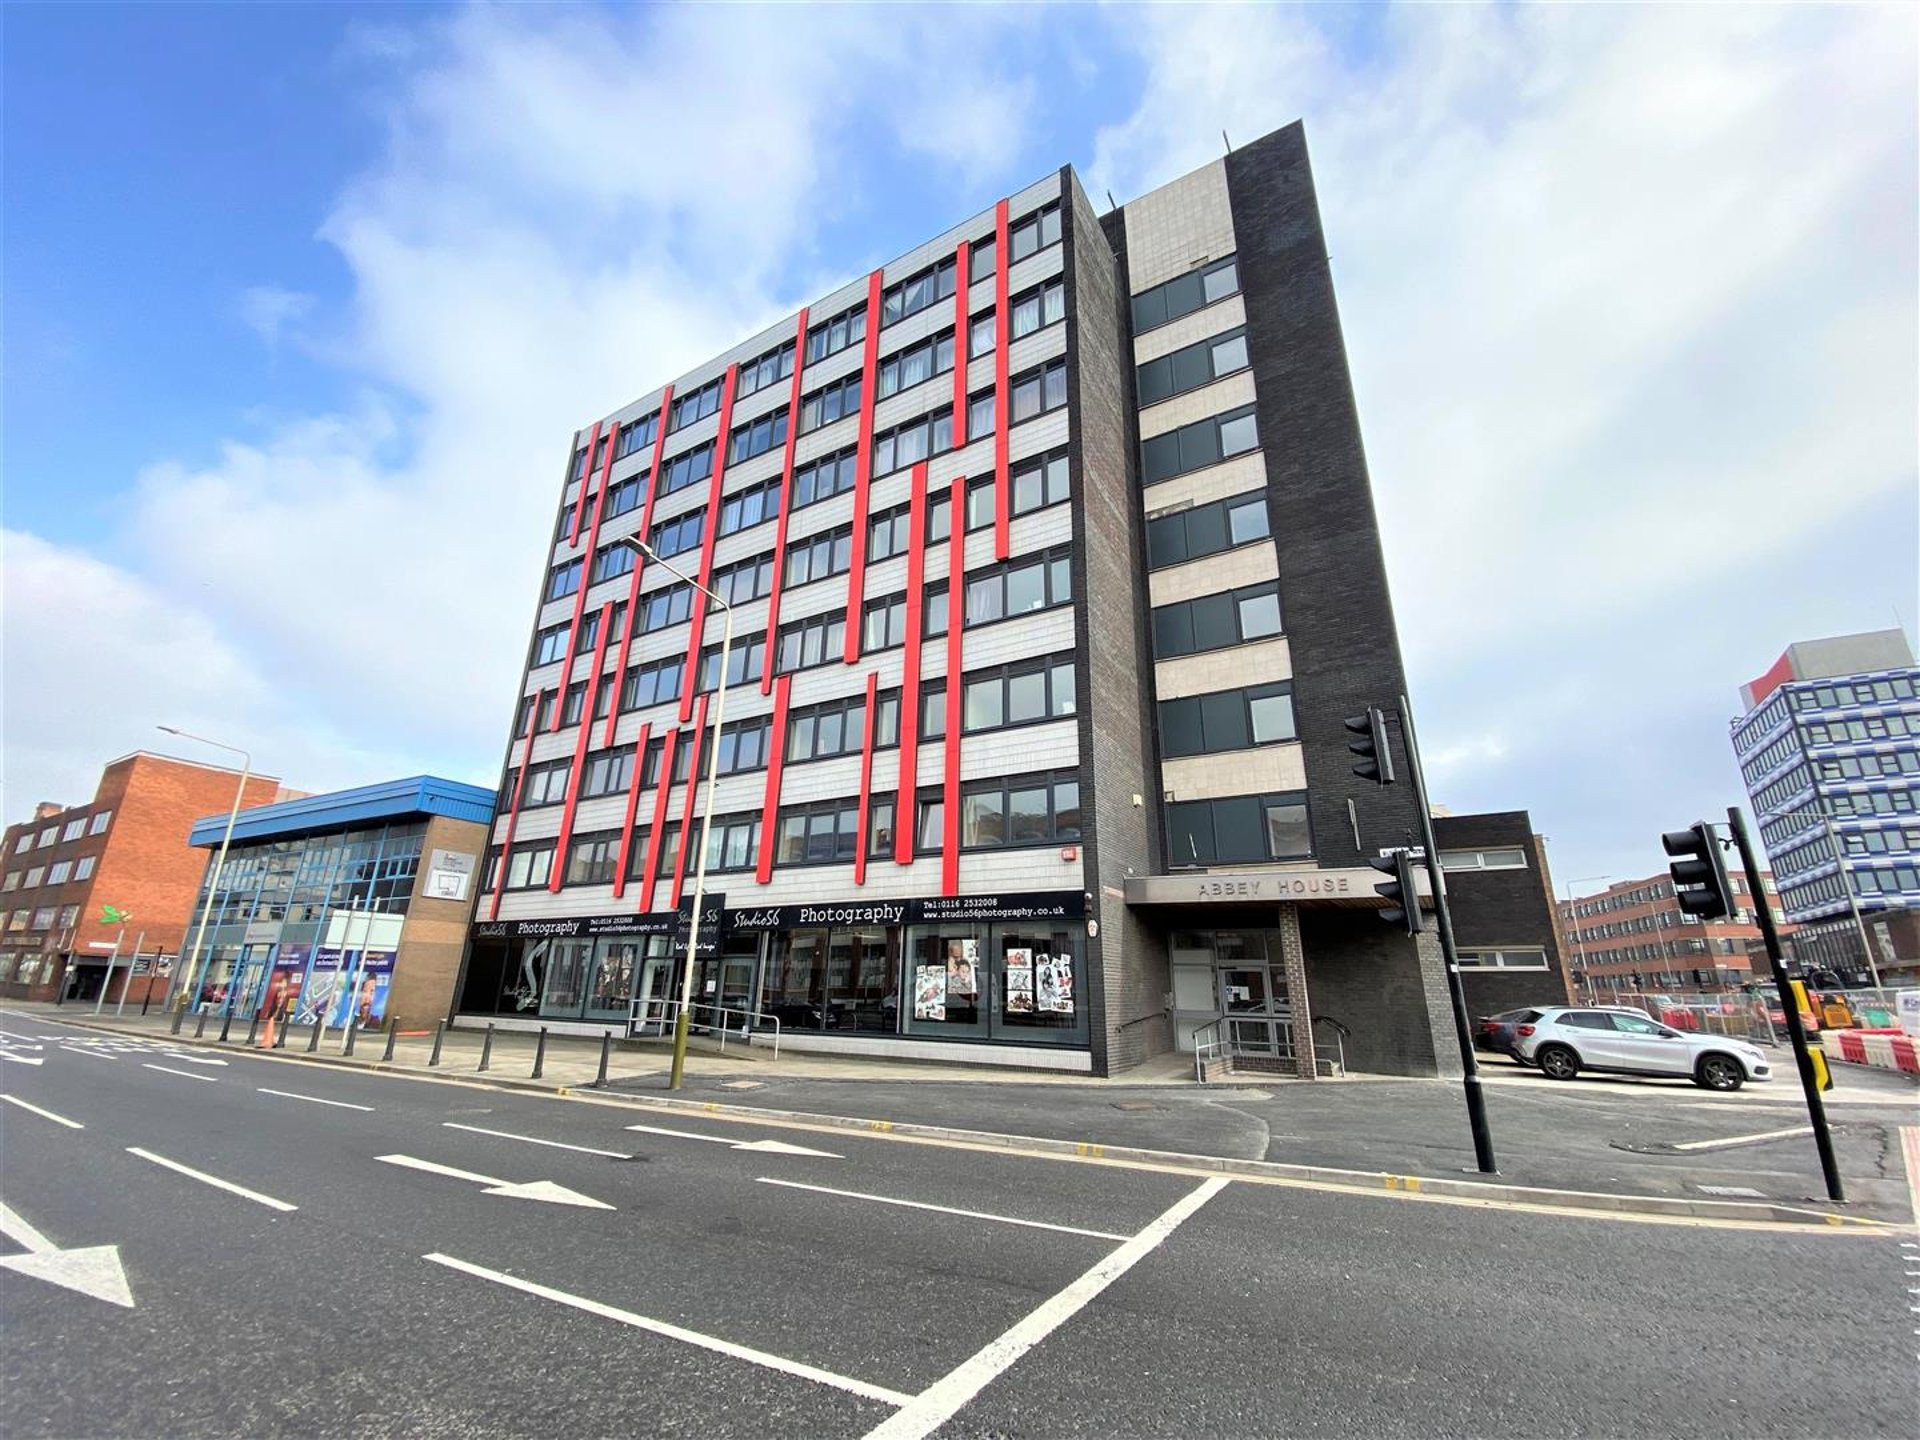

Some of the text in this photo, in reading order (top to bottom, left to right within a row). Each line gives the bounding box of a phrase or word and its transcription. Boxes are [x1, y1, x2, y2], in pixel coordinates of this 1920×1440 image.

[1199, 878, 1349, 896] ABBEY HOUSE
[923, 898, 998, 909] Tel:0116 2532008
[706, 909, 719, 923] 56
[733, 907, 781, 928] Studio56
[799, 903, 905, 925] Photography
[923, 906, 1065, 919] www.studio56photography.co.uk
[517, 920, 580, 936] Photography
